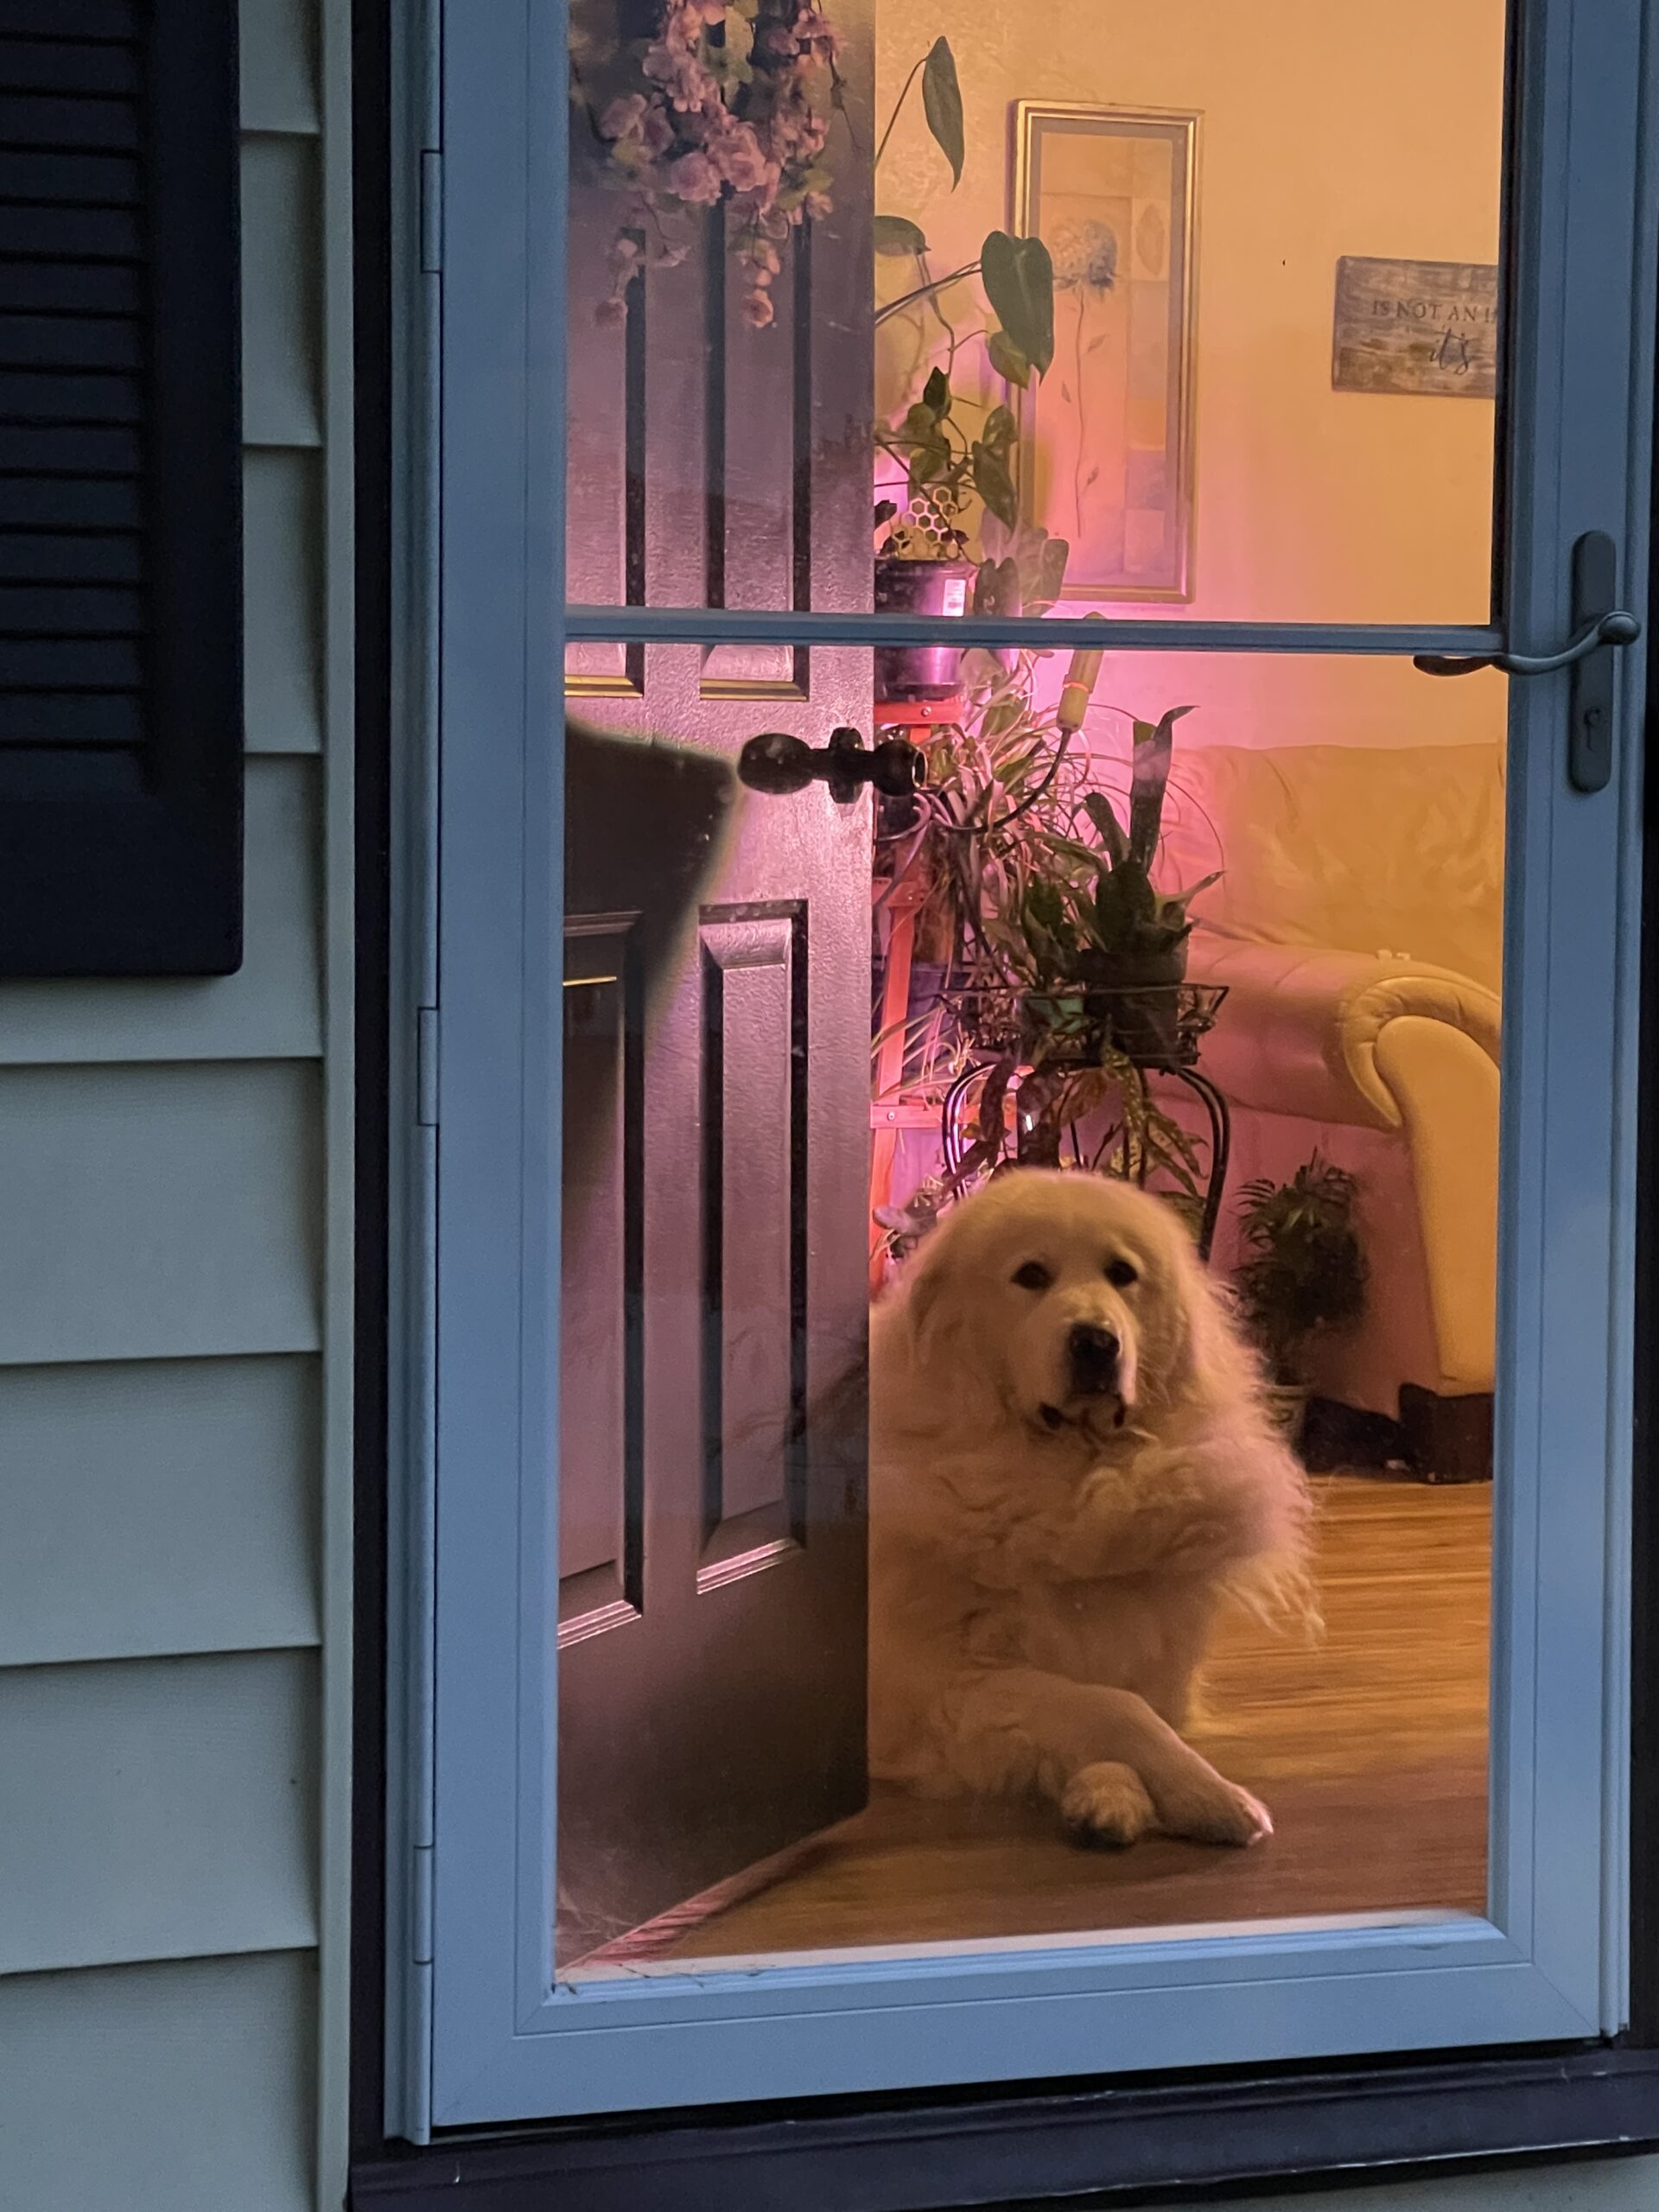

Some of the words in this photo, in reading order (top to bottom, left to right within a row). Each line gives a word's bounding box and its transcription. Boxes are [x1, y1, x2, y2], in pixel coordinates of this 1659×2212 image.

[1372, 300, 1389, 316] IS
[1397, 301, 1442, 320] NOT
[1447, 305, 1478, 322] AN
